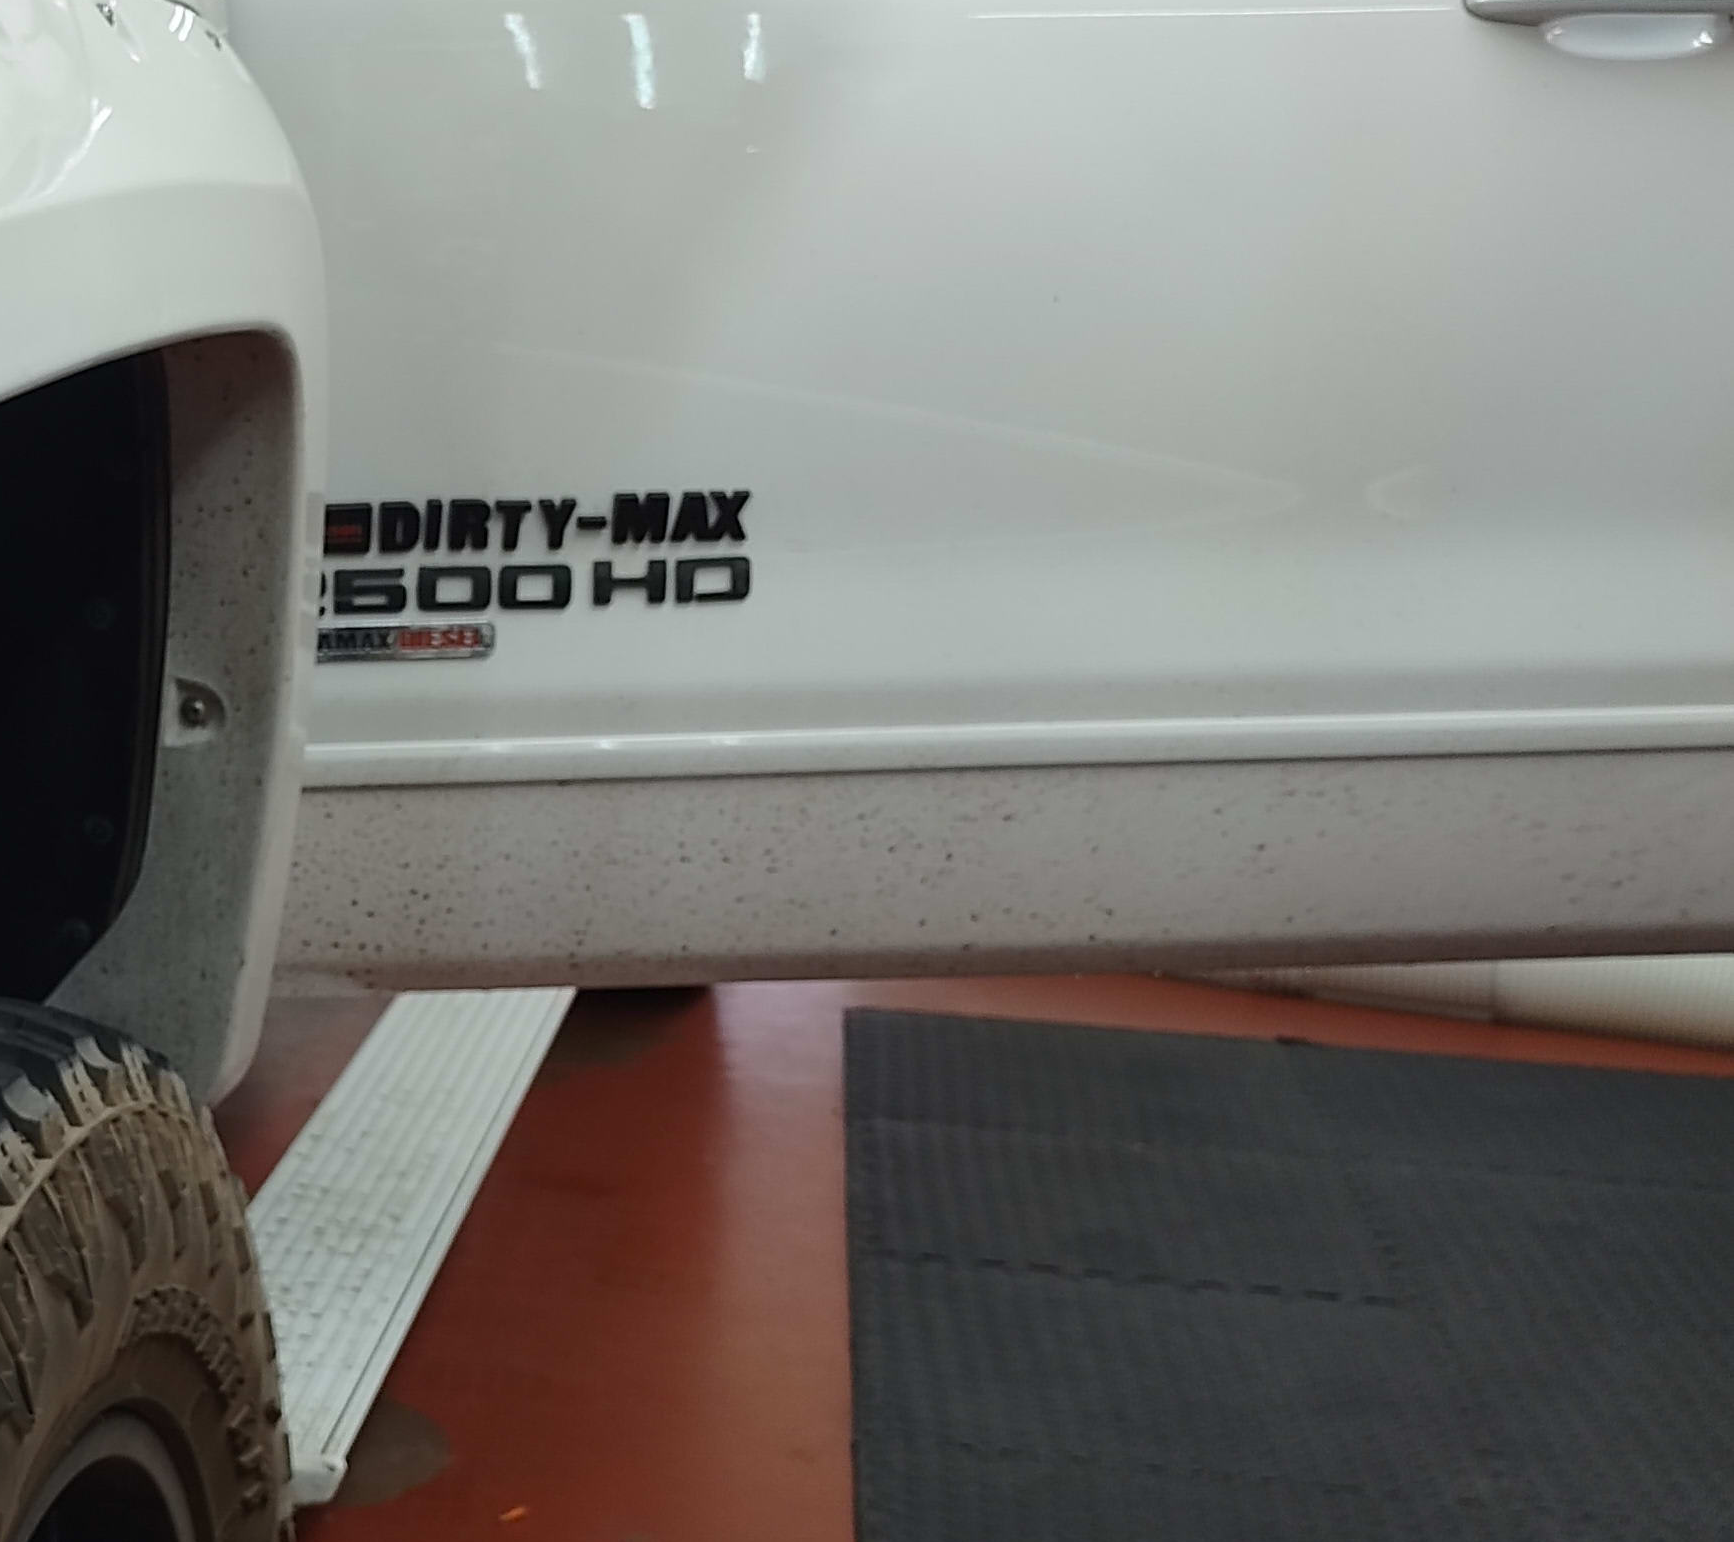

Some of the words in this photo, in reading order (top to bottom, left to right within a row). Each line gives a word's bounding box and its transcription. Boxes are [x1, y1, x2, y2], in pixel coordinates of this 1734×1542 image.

[378, 490, 751, 554] DIRTY-MAX
[318, 564, 572, 616] 500
[592, 557, 751, 608] HD
